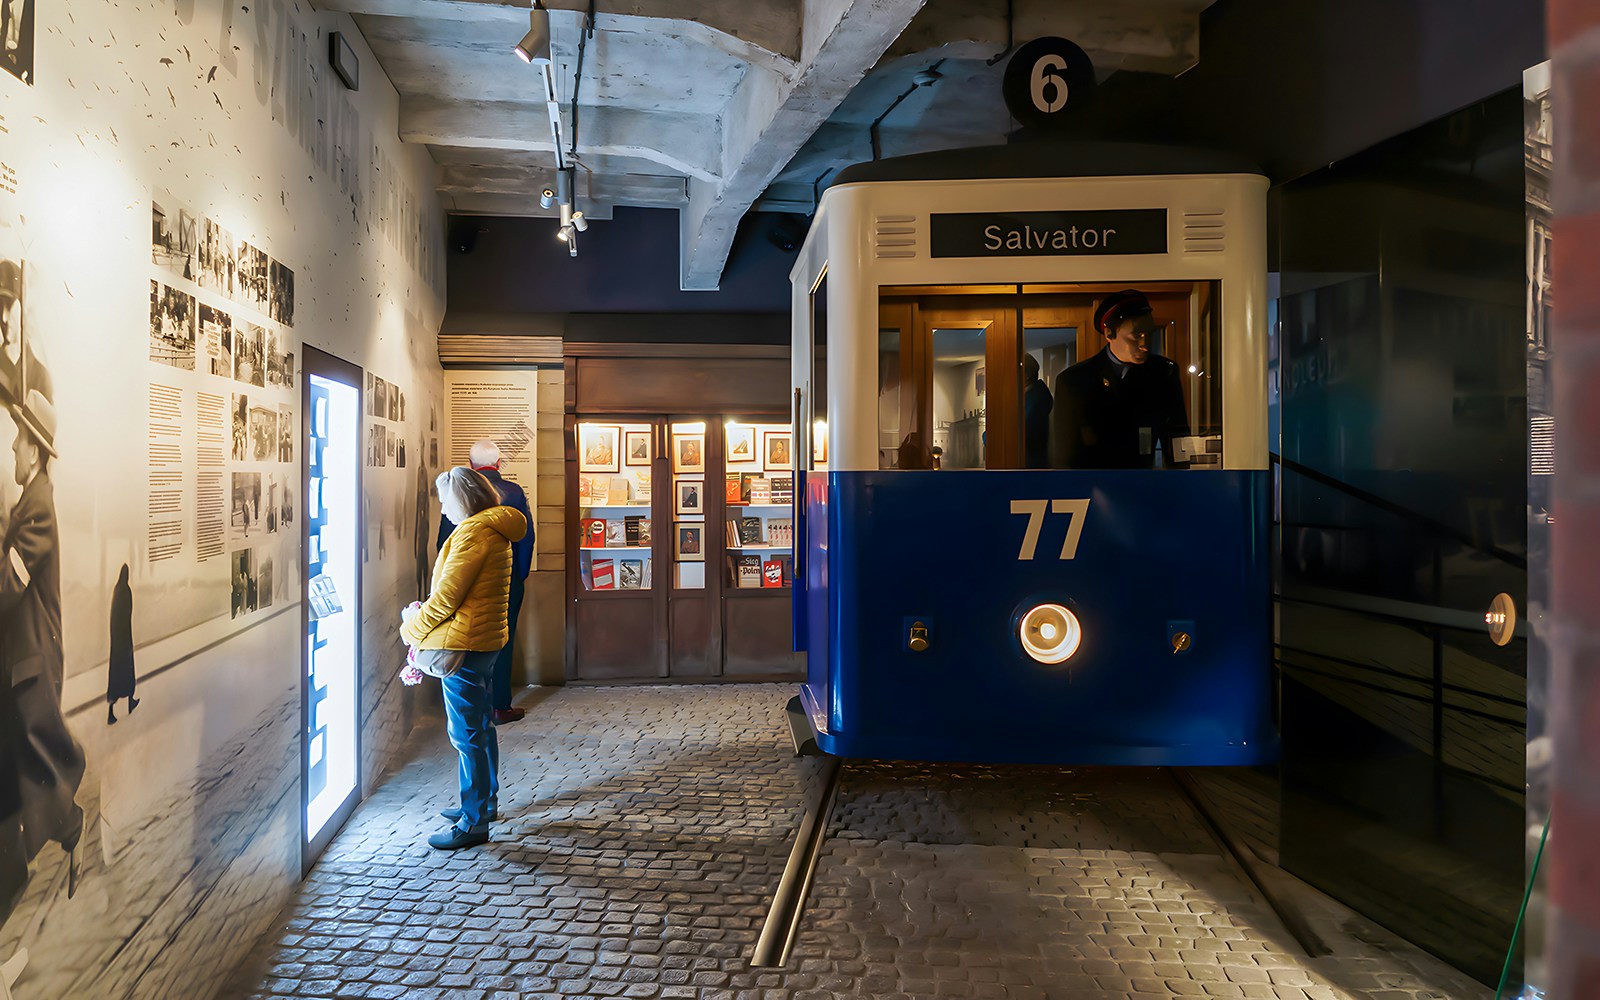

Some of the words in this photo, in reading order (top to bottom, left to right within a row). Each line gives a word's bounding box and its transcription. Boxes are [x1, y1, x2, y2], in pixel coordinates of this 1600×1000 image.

[1030, 54, 1068, 114] 6
[984, 225, 1117, 252] Salvator
[1010, 498, 1091, 561] 77
